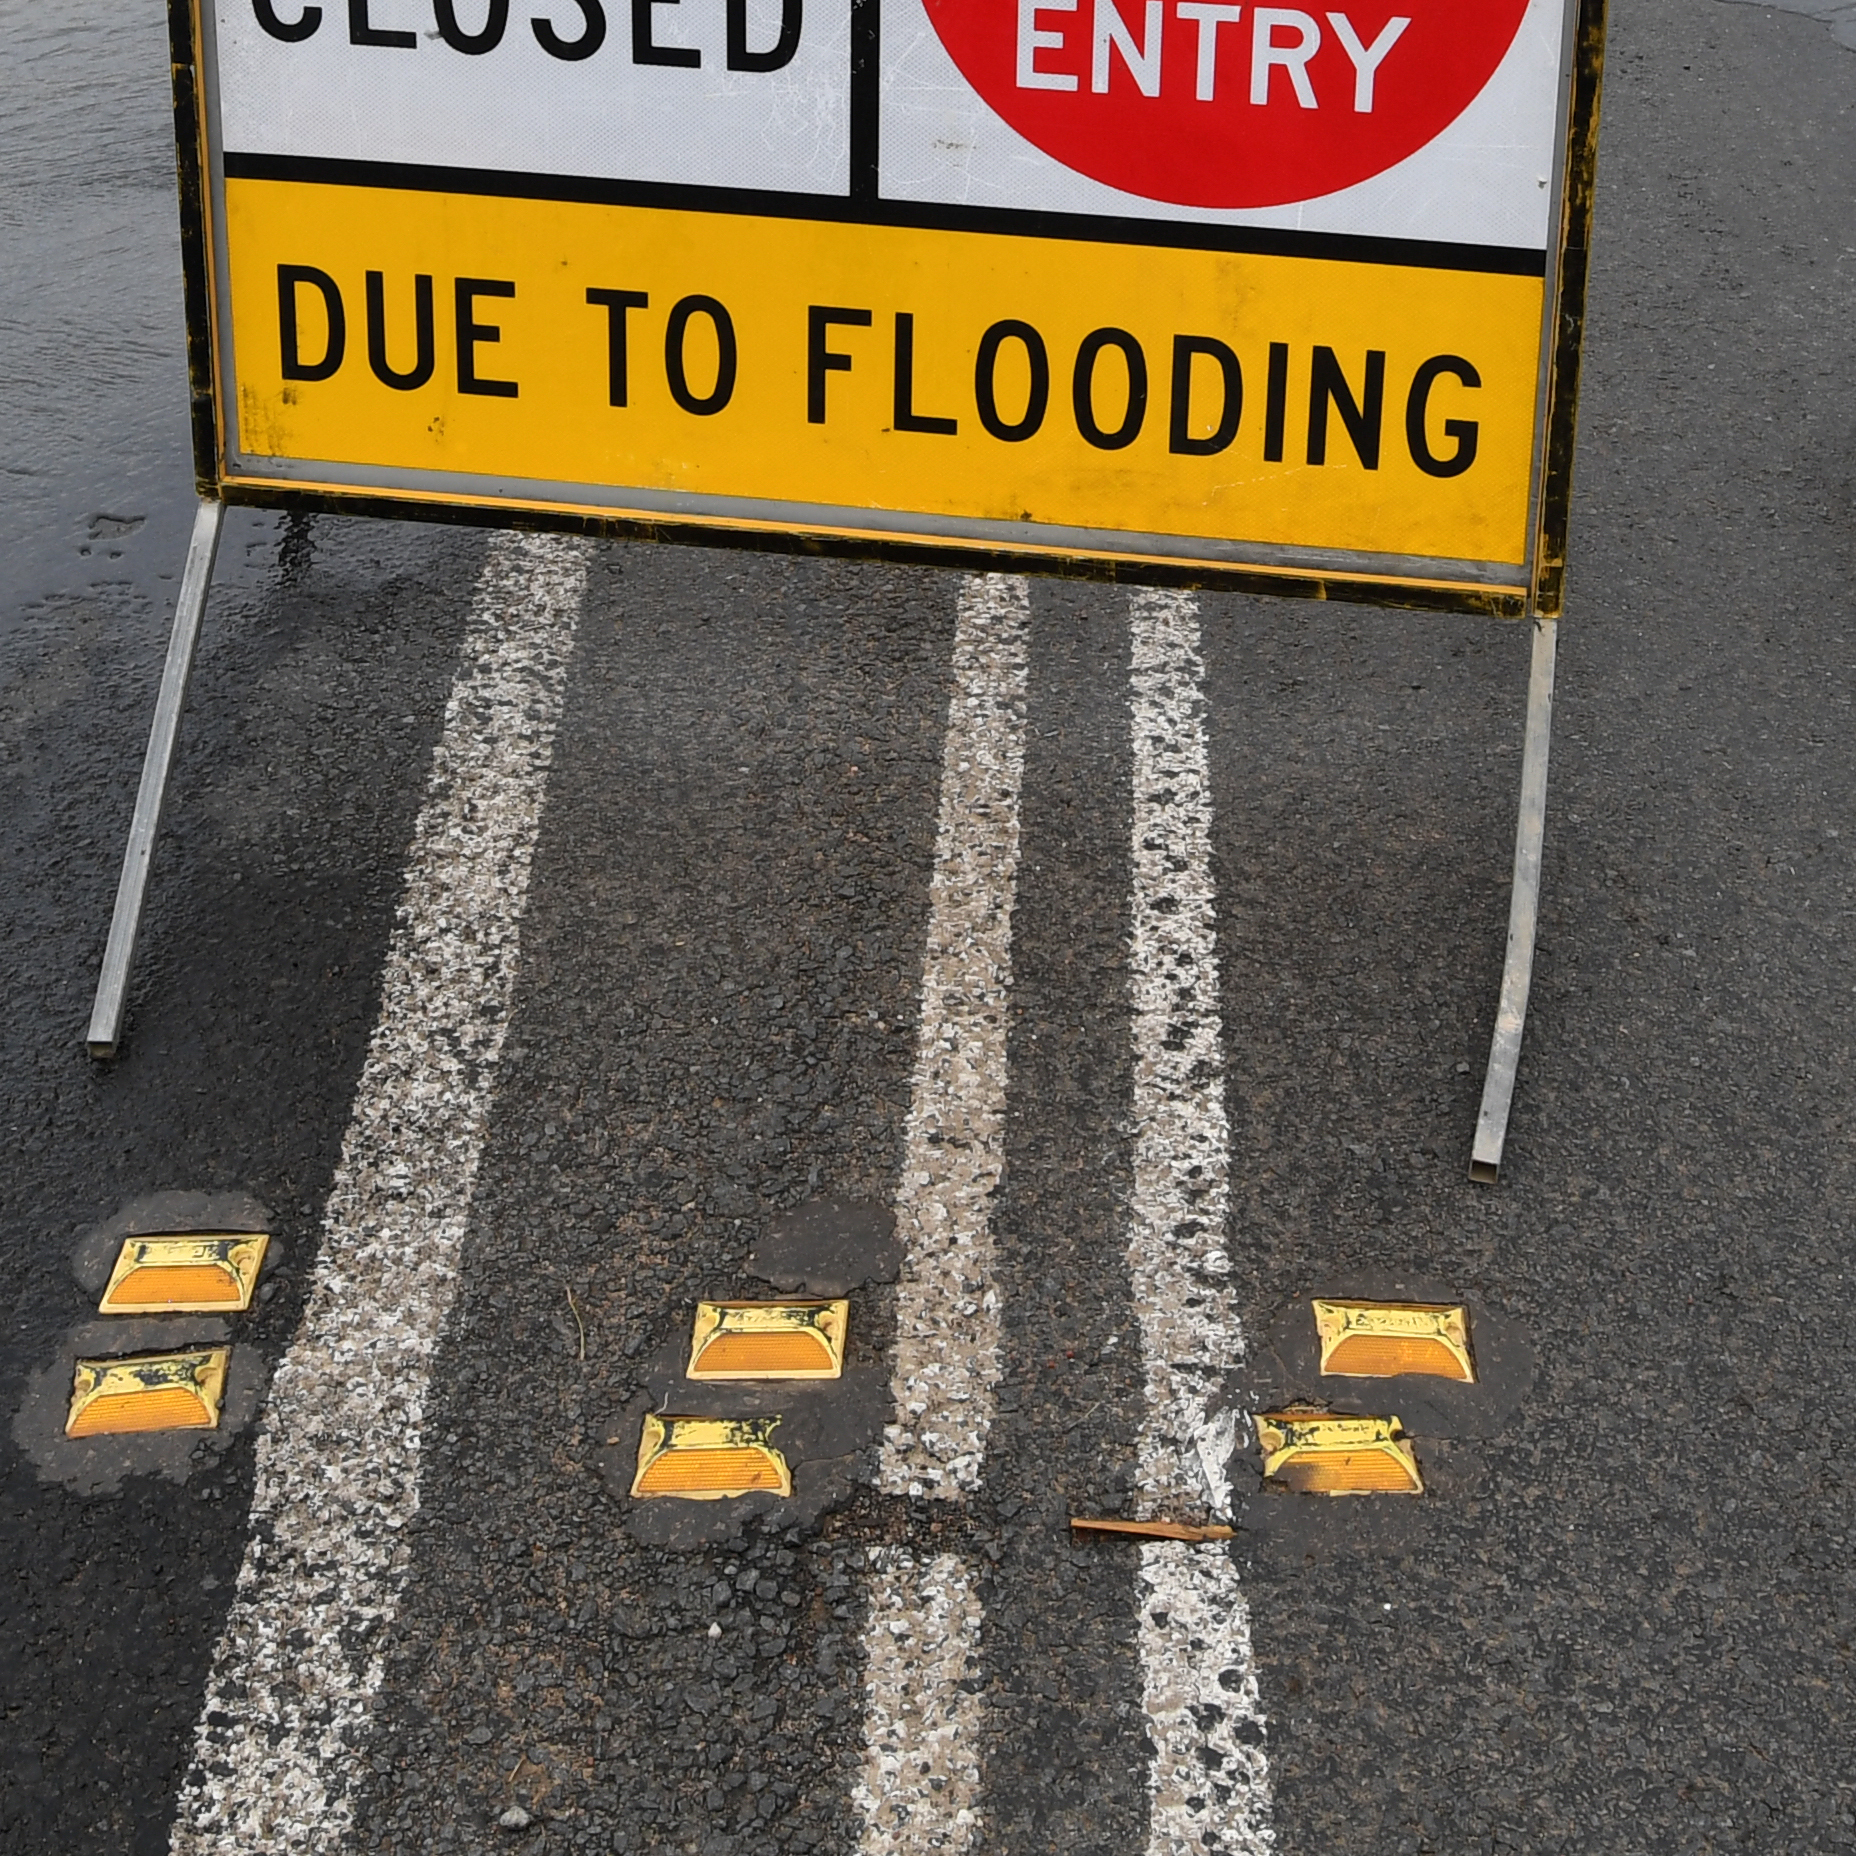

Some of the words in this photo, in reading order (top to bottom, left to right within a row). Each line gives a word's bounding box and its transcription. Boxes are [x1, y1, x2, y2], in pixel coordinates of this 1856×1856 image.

[276, 263, 520, 400] DUE
[585, 287, 738, 416] TO
[806, 305, 1484, 479] FLOODING
